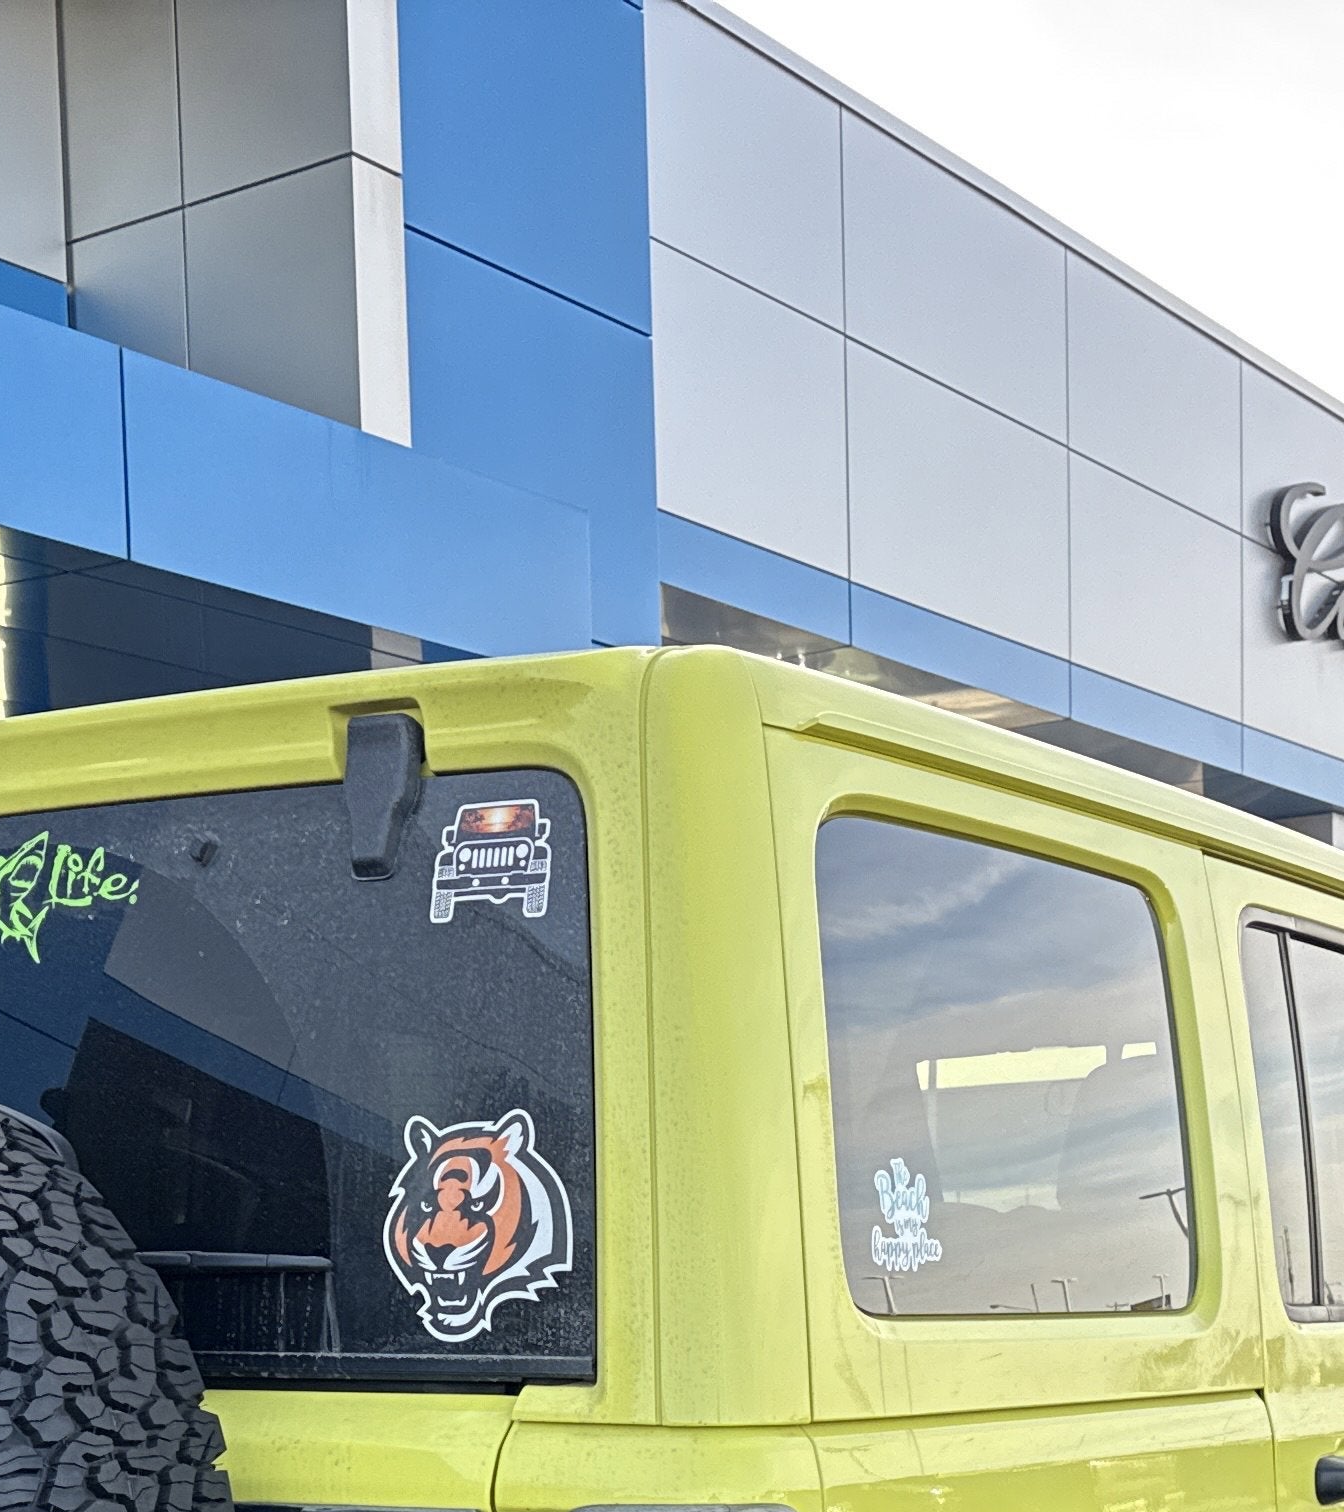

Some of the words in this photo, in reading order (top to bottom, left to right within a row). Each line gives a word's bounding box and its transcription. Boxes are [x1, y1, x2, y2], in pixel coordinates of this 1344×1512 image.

[876, 1173, 928, 1219] Beach
[873, 1229, 909, 1268] happy
[912, 1231, 940, 1268] place
